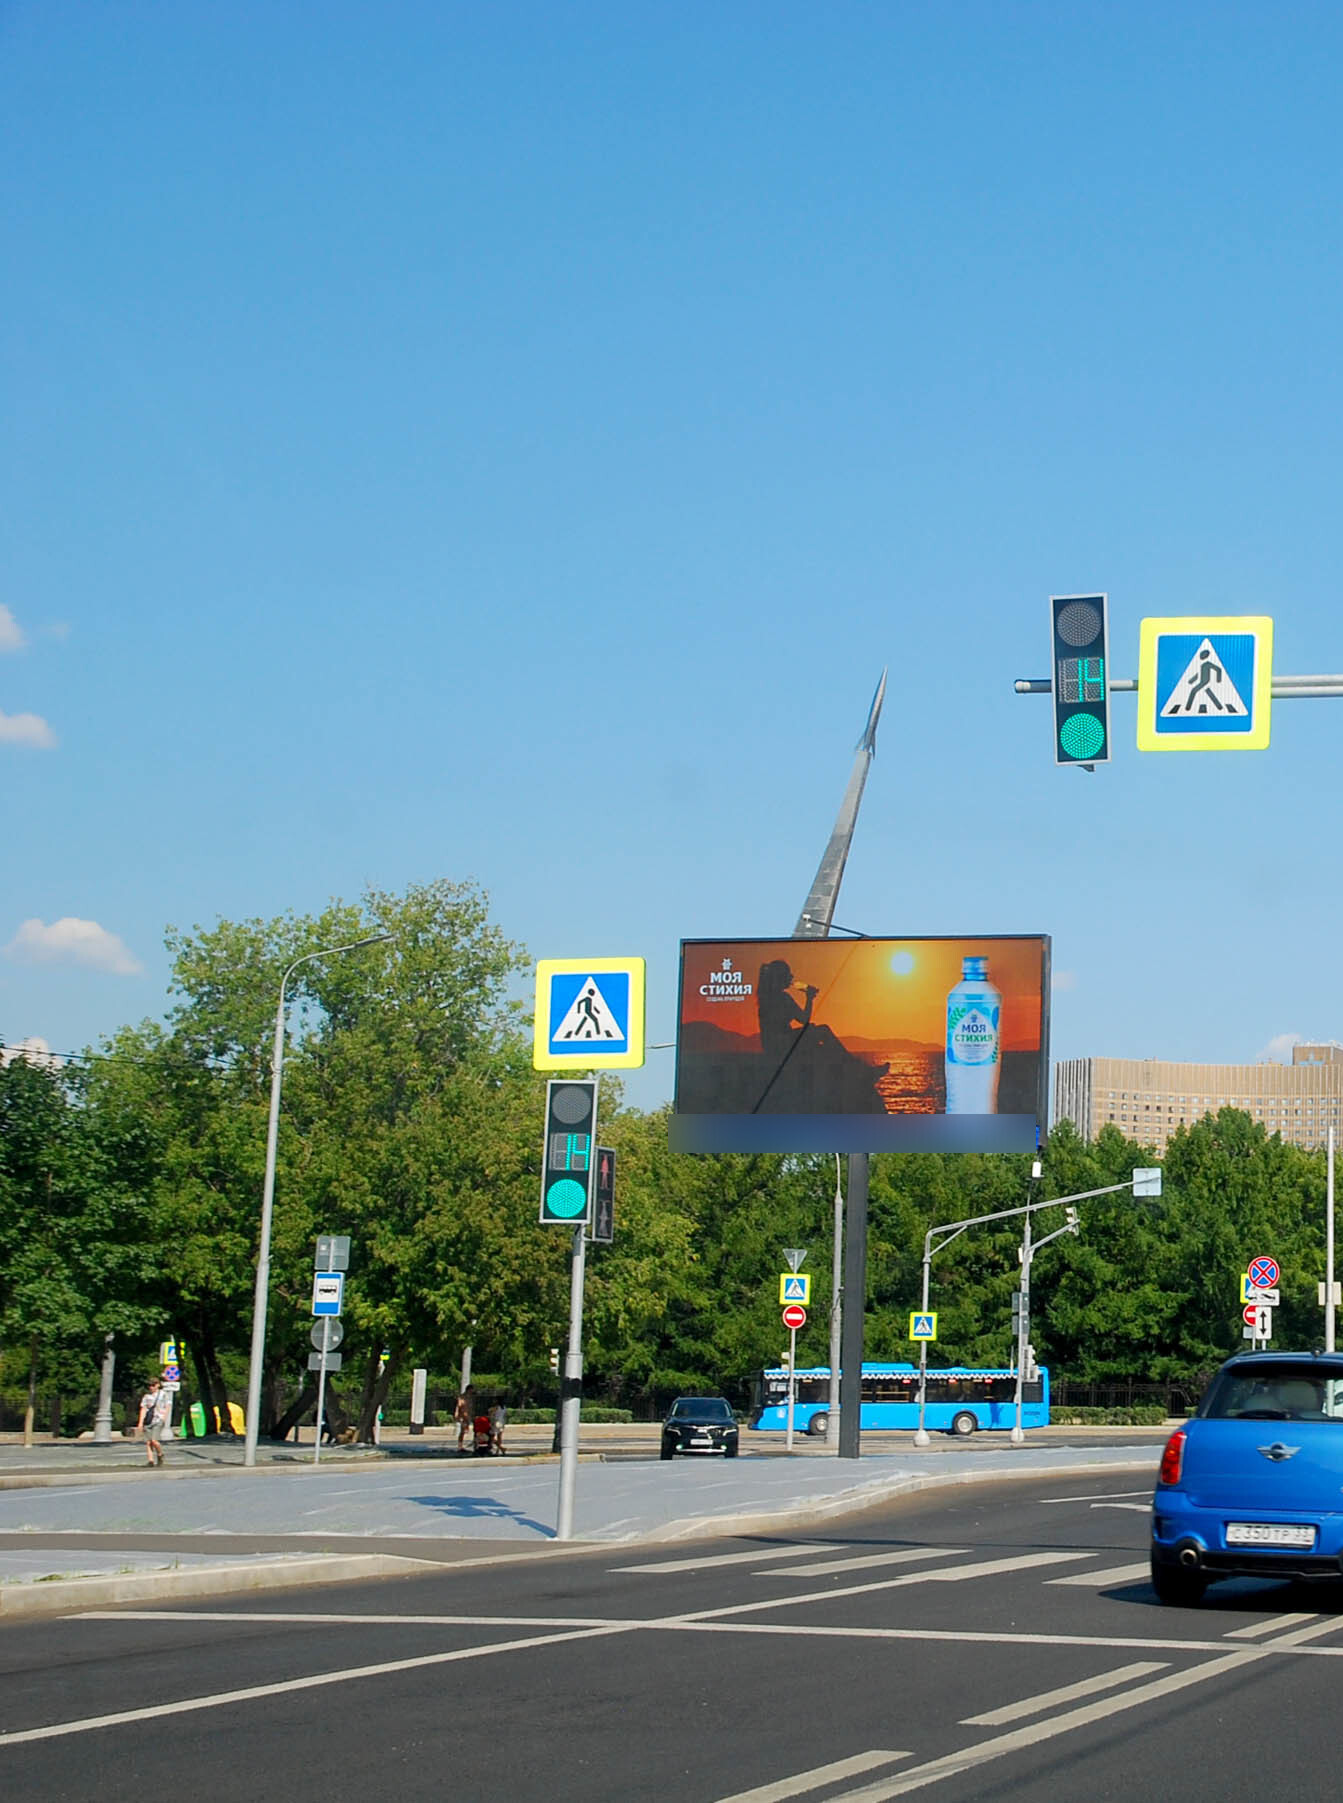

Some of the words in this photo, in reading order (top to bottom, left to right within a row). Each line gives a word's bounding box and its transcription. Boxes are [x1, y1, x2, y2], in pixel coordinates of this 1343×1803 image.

[710, 971, 742, 983] МОЯ
[699, 984, 752, 995] СТИХИЯ
[962, 1024, 986, 1033] МОЯ
[955, 1034, 993, 1042] СТИХИЯ
